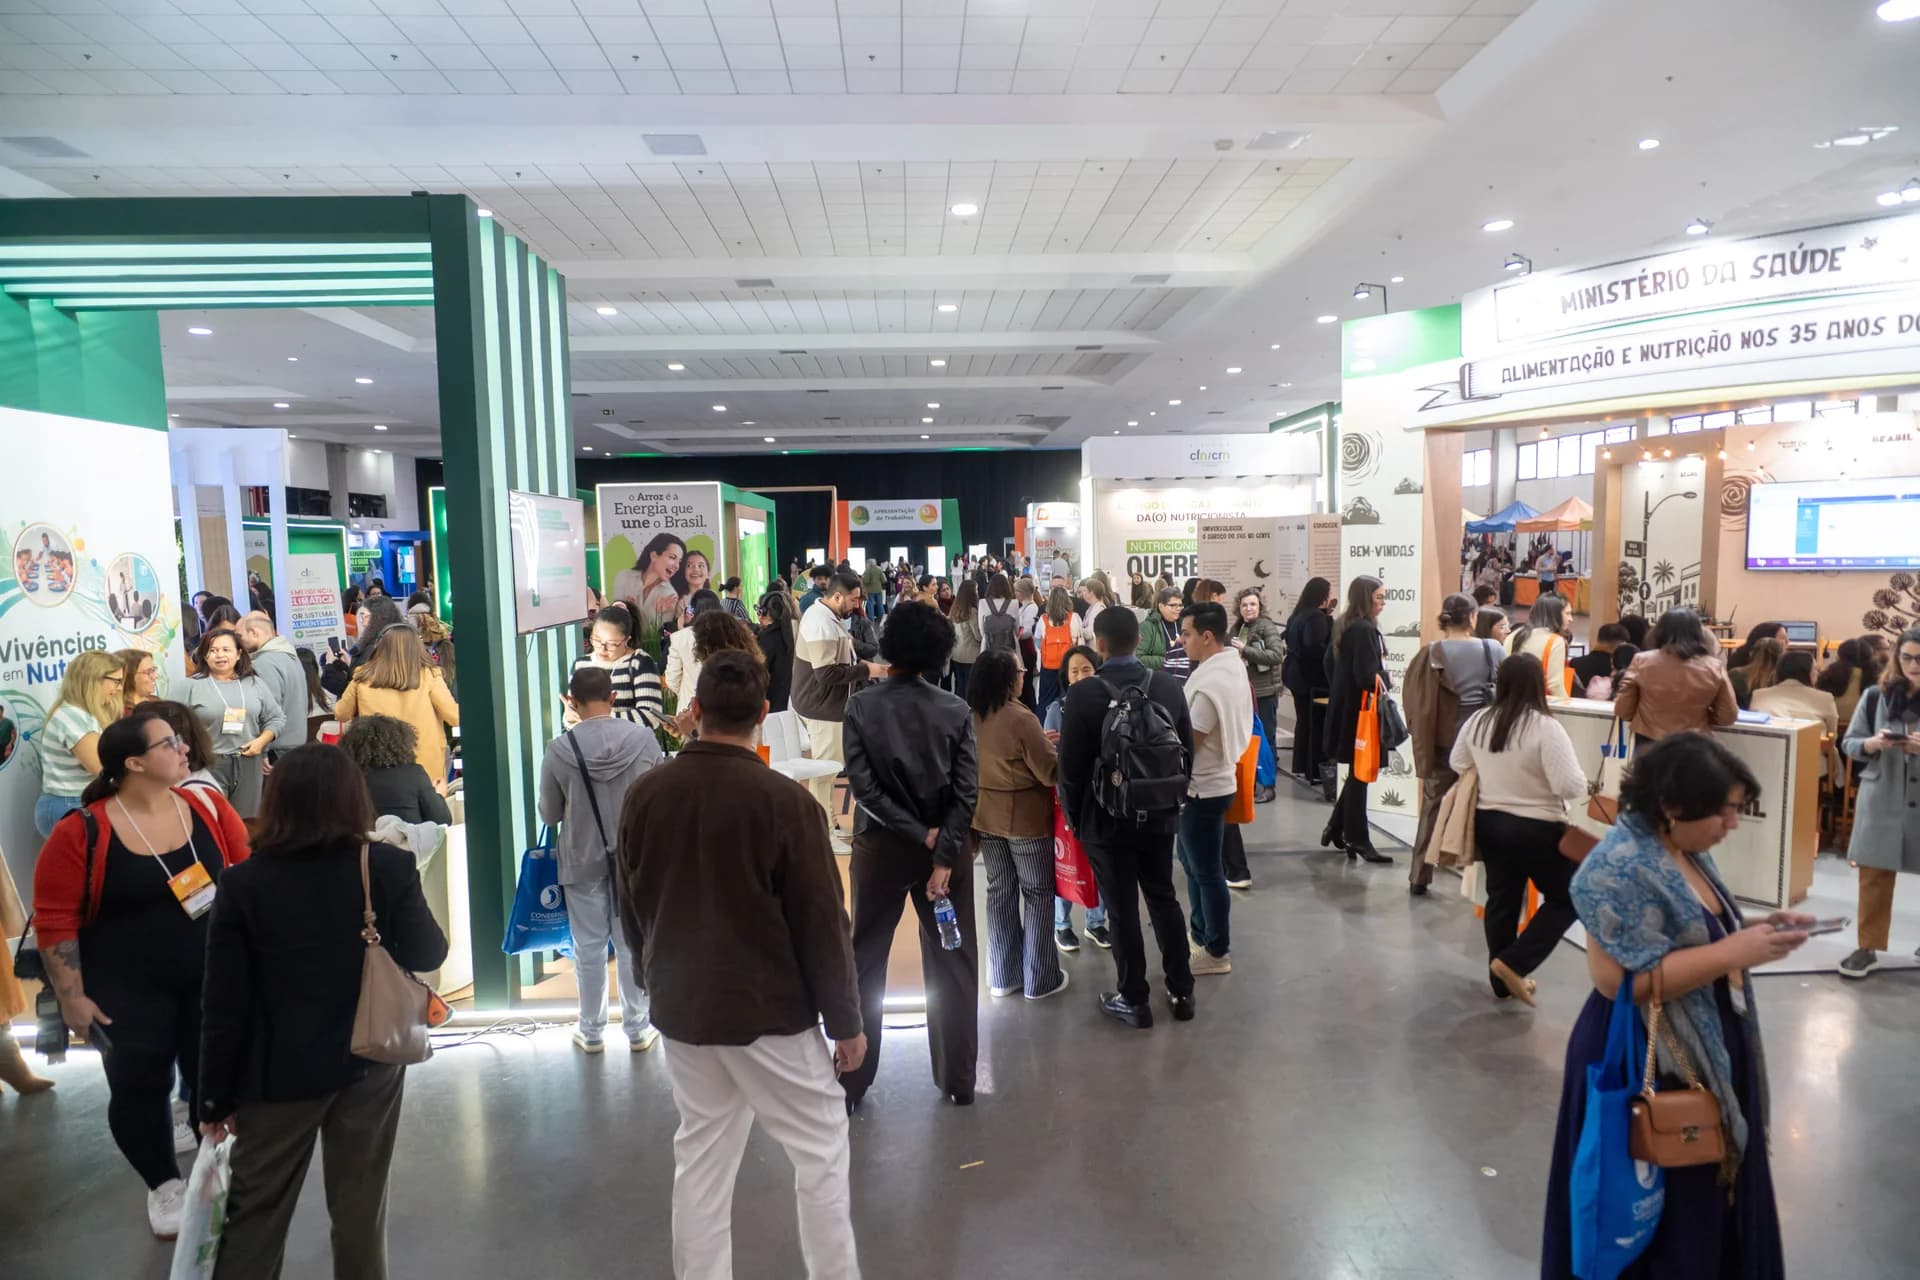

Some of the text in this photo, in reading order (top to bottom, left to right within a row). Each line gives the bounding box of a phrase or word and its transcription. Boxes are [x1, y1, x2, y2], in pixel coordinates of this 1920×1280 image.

[1560, 242, 1847, 314] MINISTÉRIO DA SAÚDE
[1502, 346, 1615, 383] ALIMENTAÇÃO
[1622, 346, 1632, 365] E
[1640, 330, 1732, 362] NUTRIÇÃO
[1740, 327, 1778, 350] NOS
[1788, 322, 1817, 344] 35
[1827, 314, 1885, 341] ANOS
[637, 493, 664, 501] Arroz
[614, 502, 694, 517] Energia que
[621, 519, 650, 529] une
[664, 515, 707, 528] Brasil.
[1136, 511, 1246, 523] DA(O) NUTRICIONISTA
[1350, 545, 1415, 557] BEM-VINDAS
[1378, 567, 1385, 578] E
[0, 631, 107, 663] Vivências
[3, 669, 24, 681] em
